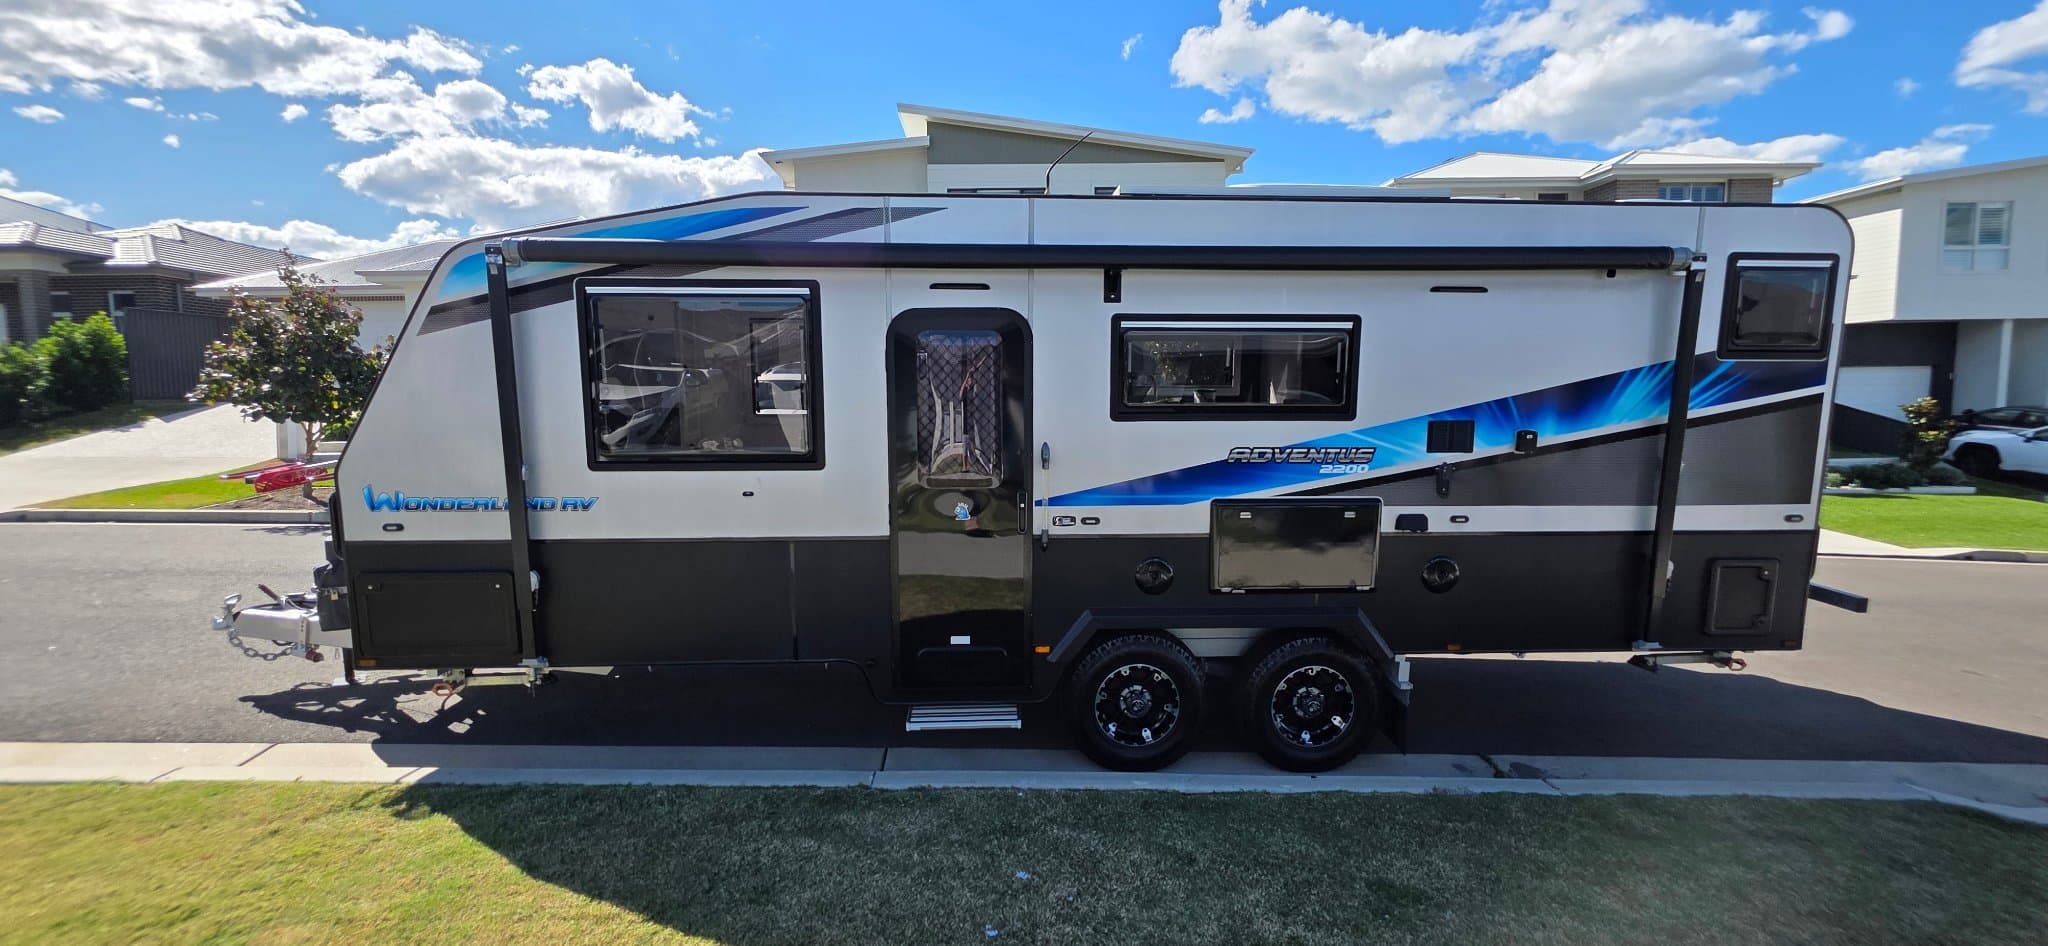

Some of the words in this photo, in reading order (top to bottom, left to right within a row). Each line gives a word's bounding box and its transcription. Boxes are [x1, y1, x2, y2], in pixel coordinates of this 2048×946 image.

[1227, 447, 1376, 464] ADVENTUS
[1319, 464, 1369, 474] 2200
[560, 496, 599, 512] RV
